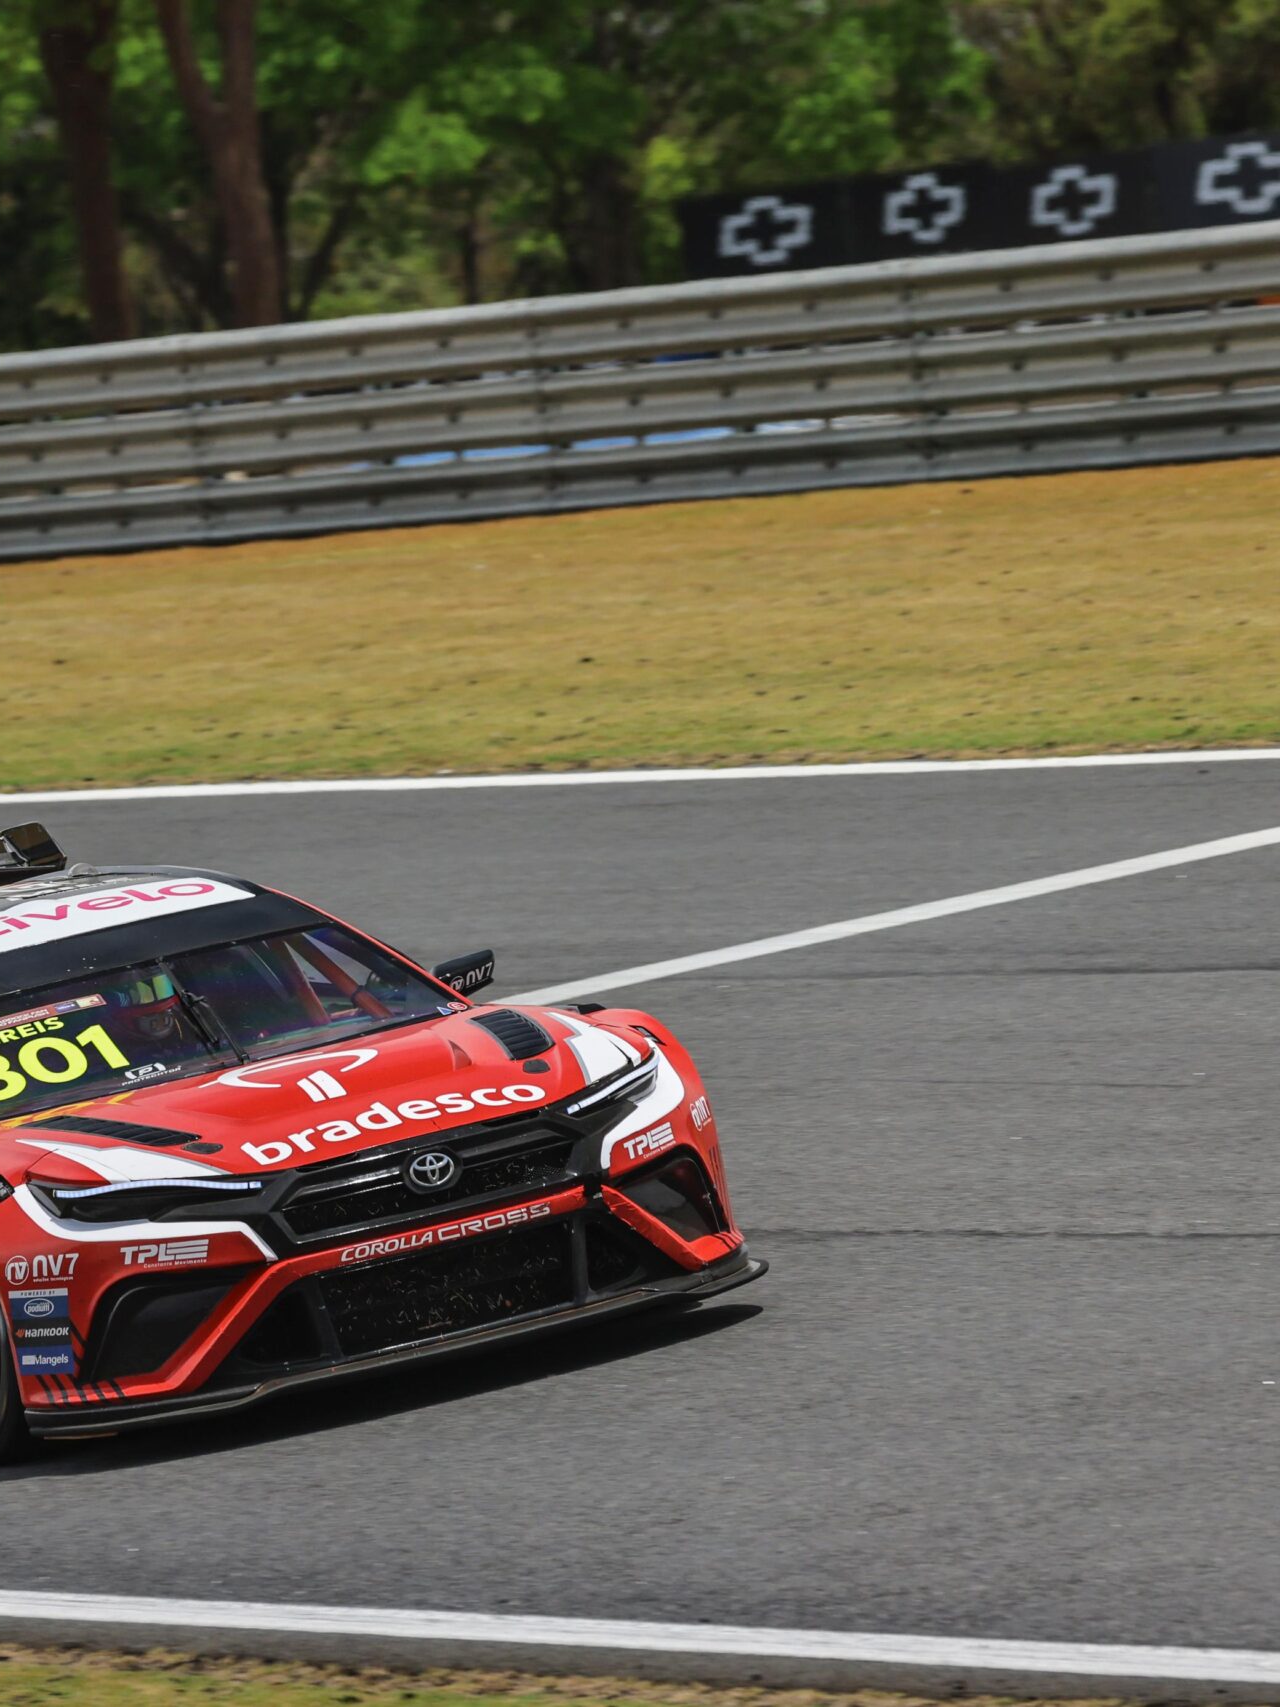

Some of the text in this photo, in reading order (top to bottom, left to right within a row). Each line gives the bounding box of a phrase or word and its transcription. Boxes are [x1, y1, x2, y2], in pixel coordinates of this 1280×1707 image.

[240, 1084, 546, 1166] bradesco
[340, 1203, 551, 1263] COROLLA CROSS
[34, 1353, 69, 1367] Mangels
